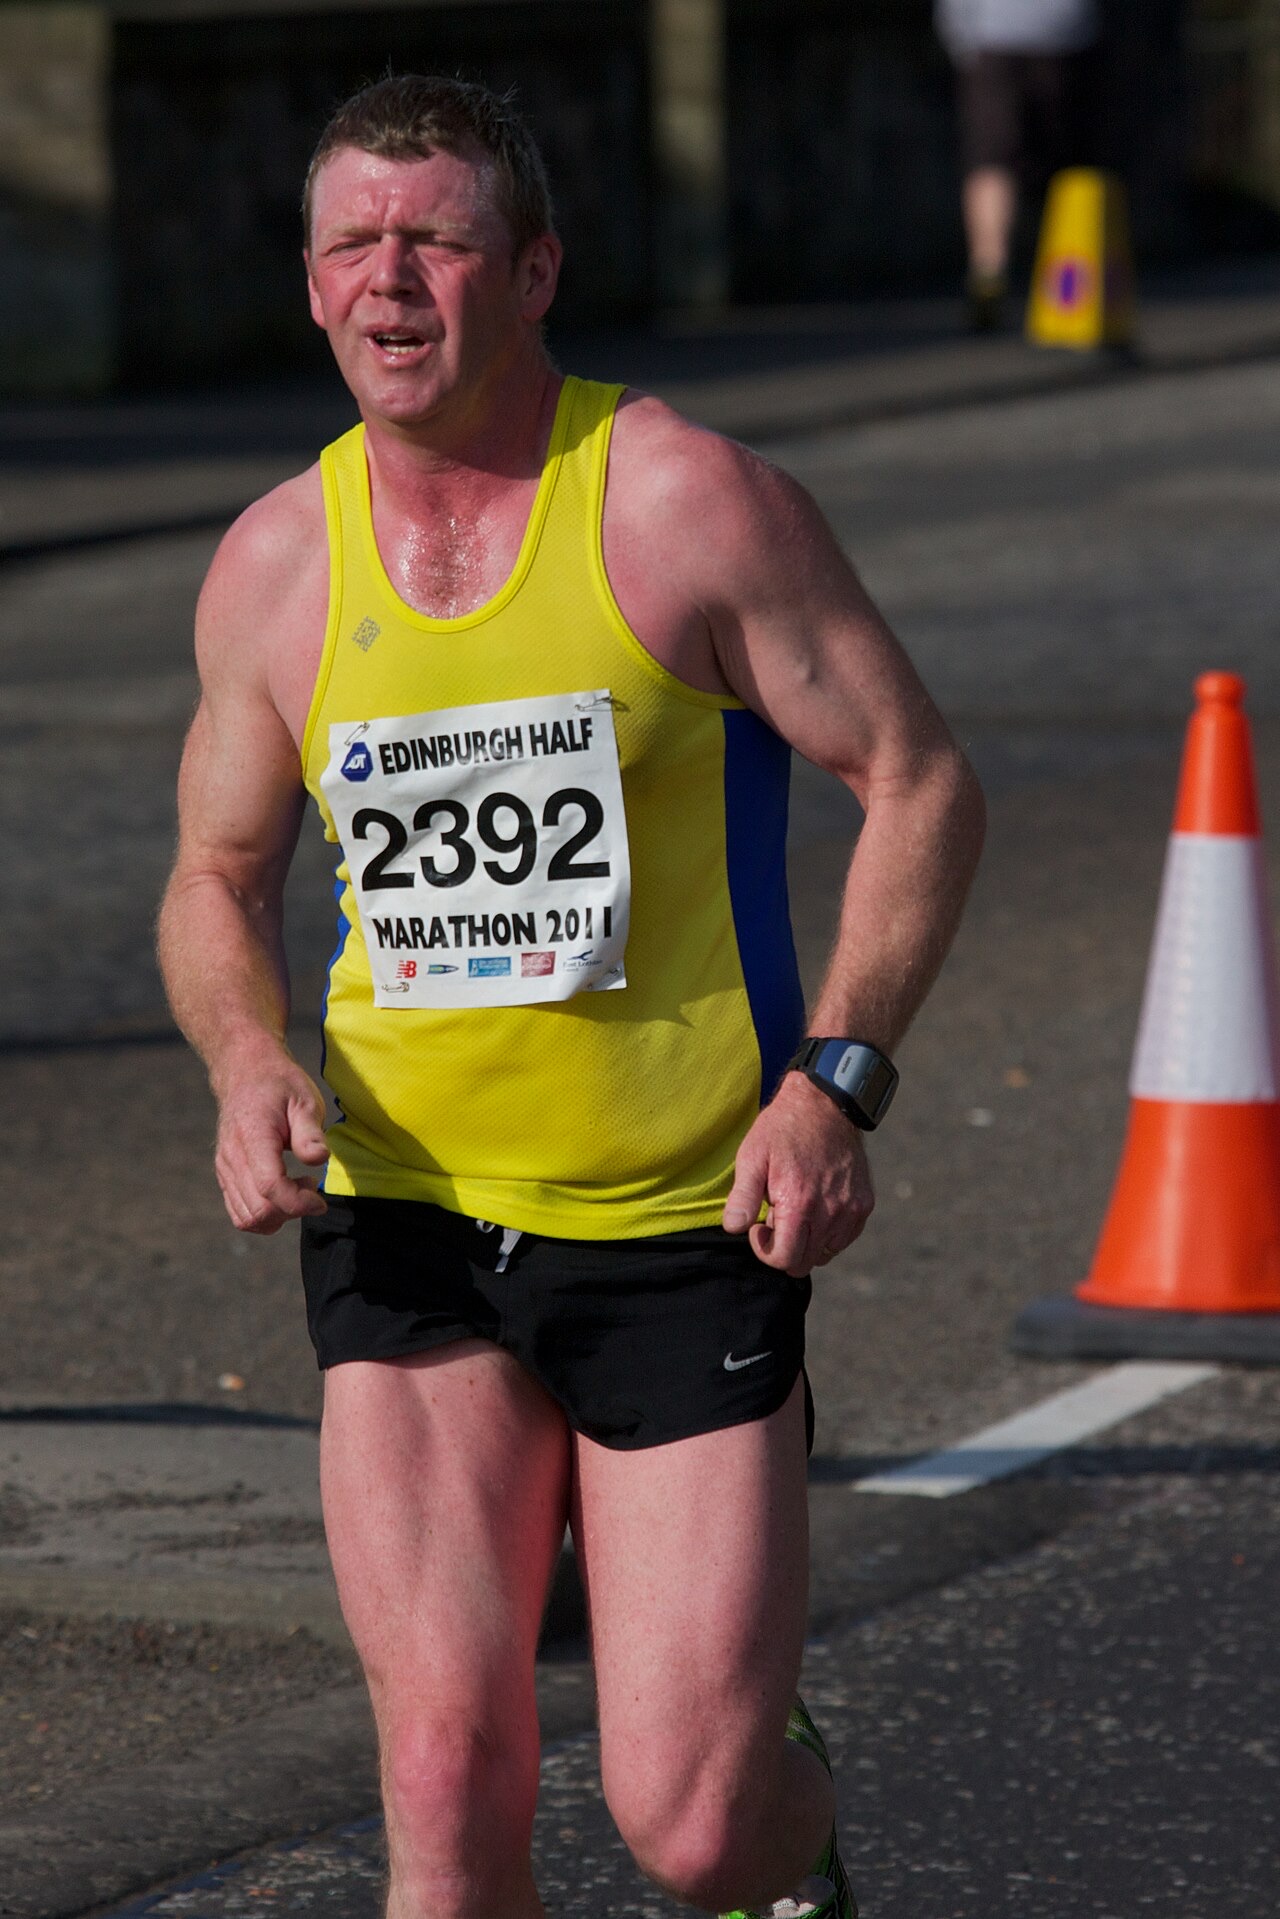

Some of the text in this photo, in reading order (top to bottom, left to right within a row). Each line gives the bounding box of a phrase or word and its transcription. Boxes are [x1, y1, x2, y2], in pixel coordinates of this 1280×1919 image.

[345, 754, 366, 770] ADT
[378, 717, 592, 775] EDINBURGH HALF
[351, 788, 610, 891] 2392
[372, 907, 612, 949] MARATHON 2011
